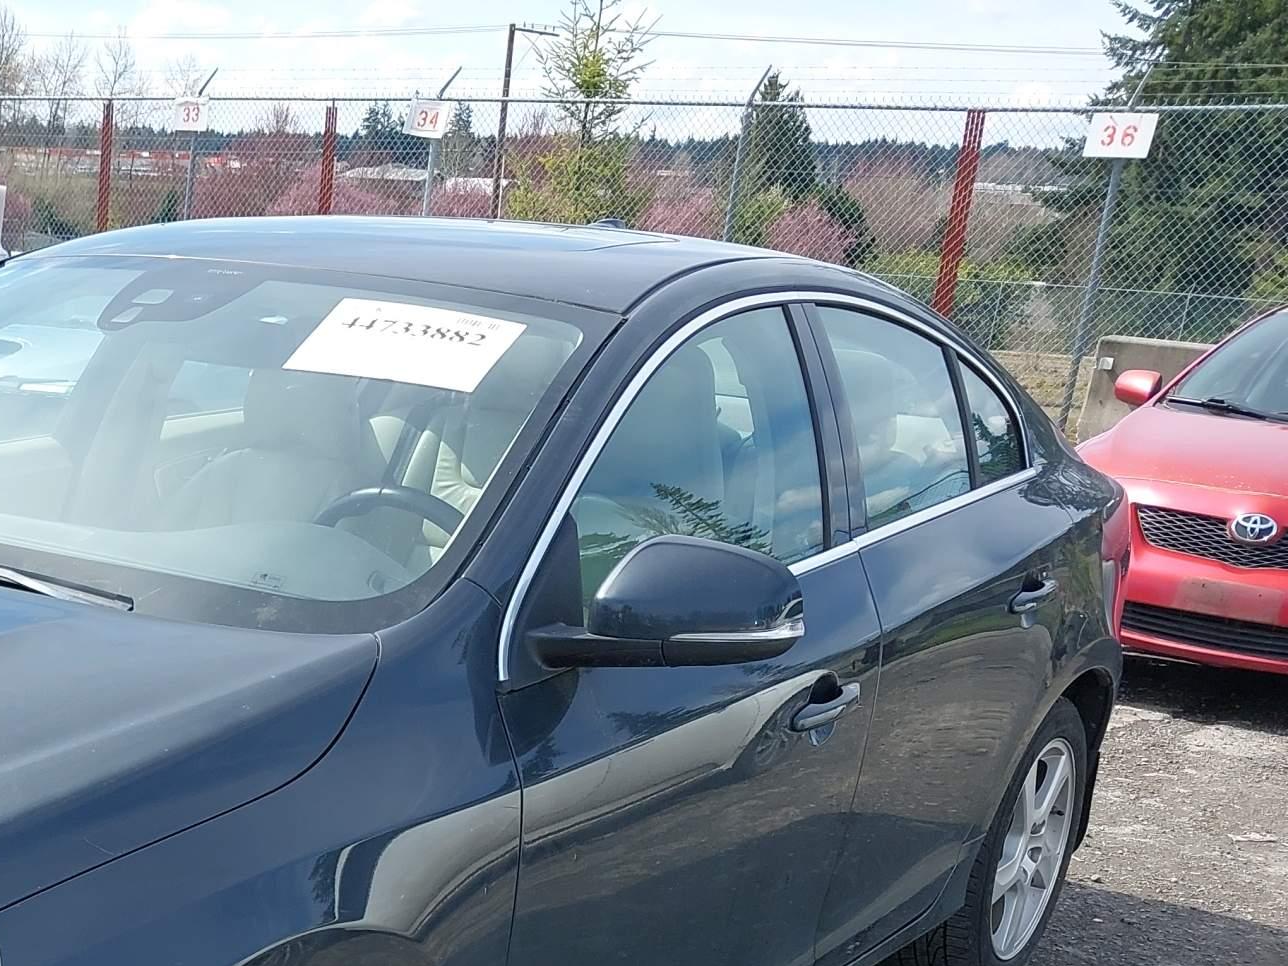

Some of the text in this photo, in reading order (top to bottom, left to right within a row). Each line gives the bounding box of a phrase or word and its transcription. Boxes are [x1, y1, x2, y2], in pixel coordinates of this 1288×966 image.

[183, 106, 200, 123] 33
[417, 110, 439, 129] 34
[1100, 124, 1138, 147] 36
[341, 316, 486, 346] 44733882
